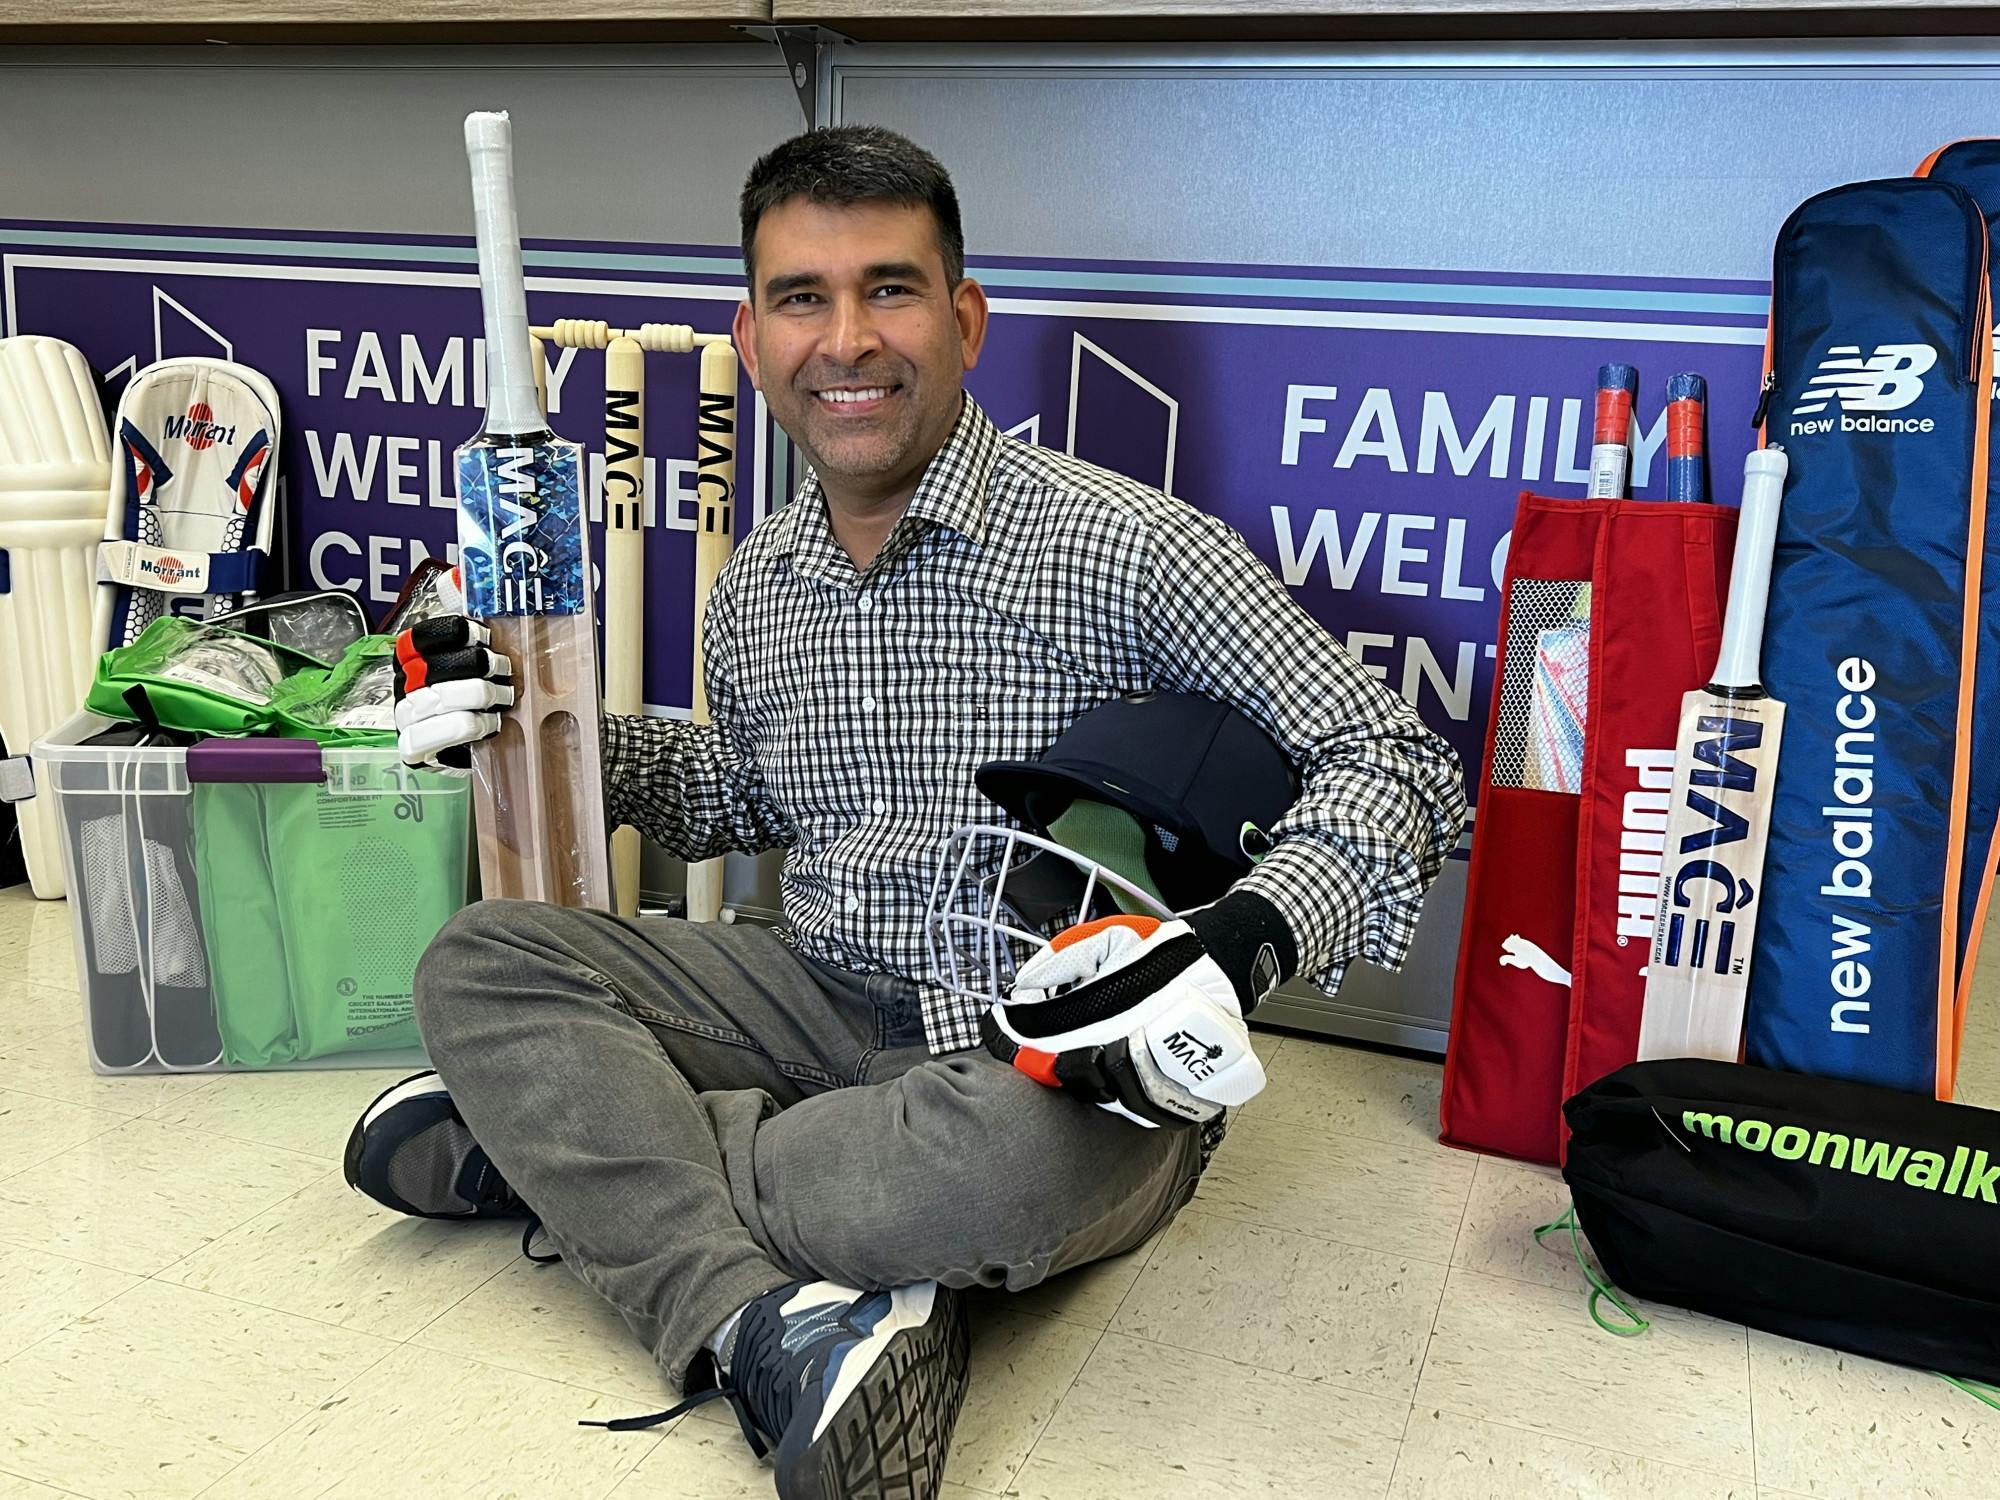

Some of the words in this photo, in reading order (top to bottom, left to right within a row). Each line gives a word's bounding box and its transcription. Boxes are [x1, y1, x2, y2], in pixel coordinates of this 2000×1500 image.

[306, 328, 578, 414] FAMIY
[1281, 384, 1668, 488] FAMILY
[1790, 416, 1834, 437] new
[1840, 414, 1936, 434] balance
[140, 559, 201, 579] Morrant
[1346, 631, 1497, 721] EN
[1821, 656, 1877, 898] balance
[1830, 915, 1872, 1034] new
